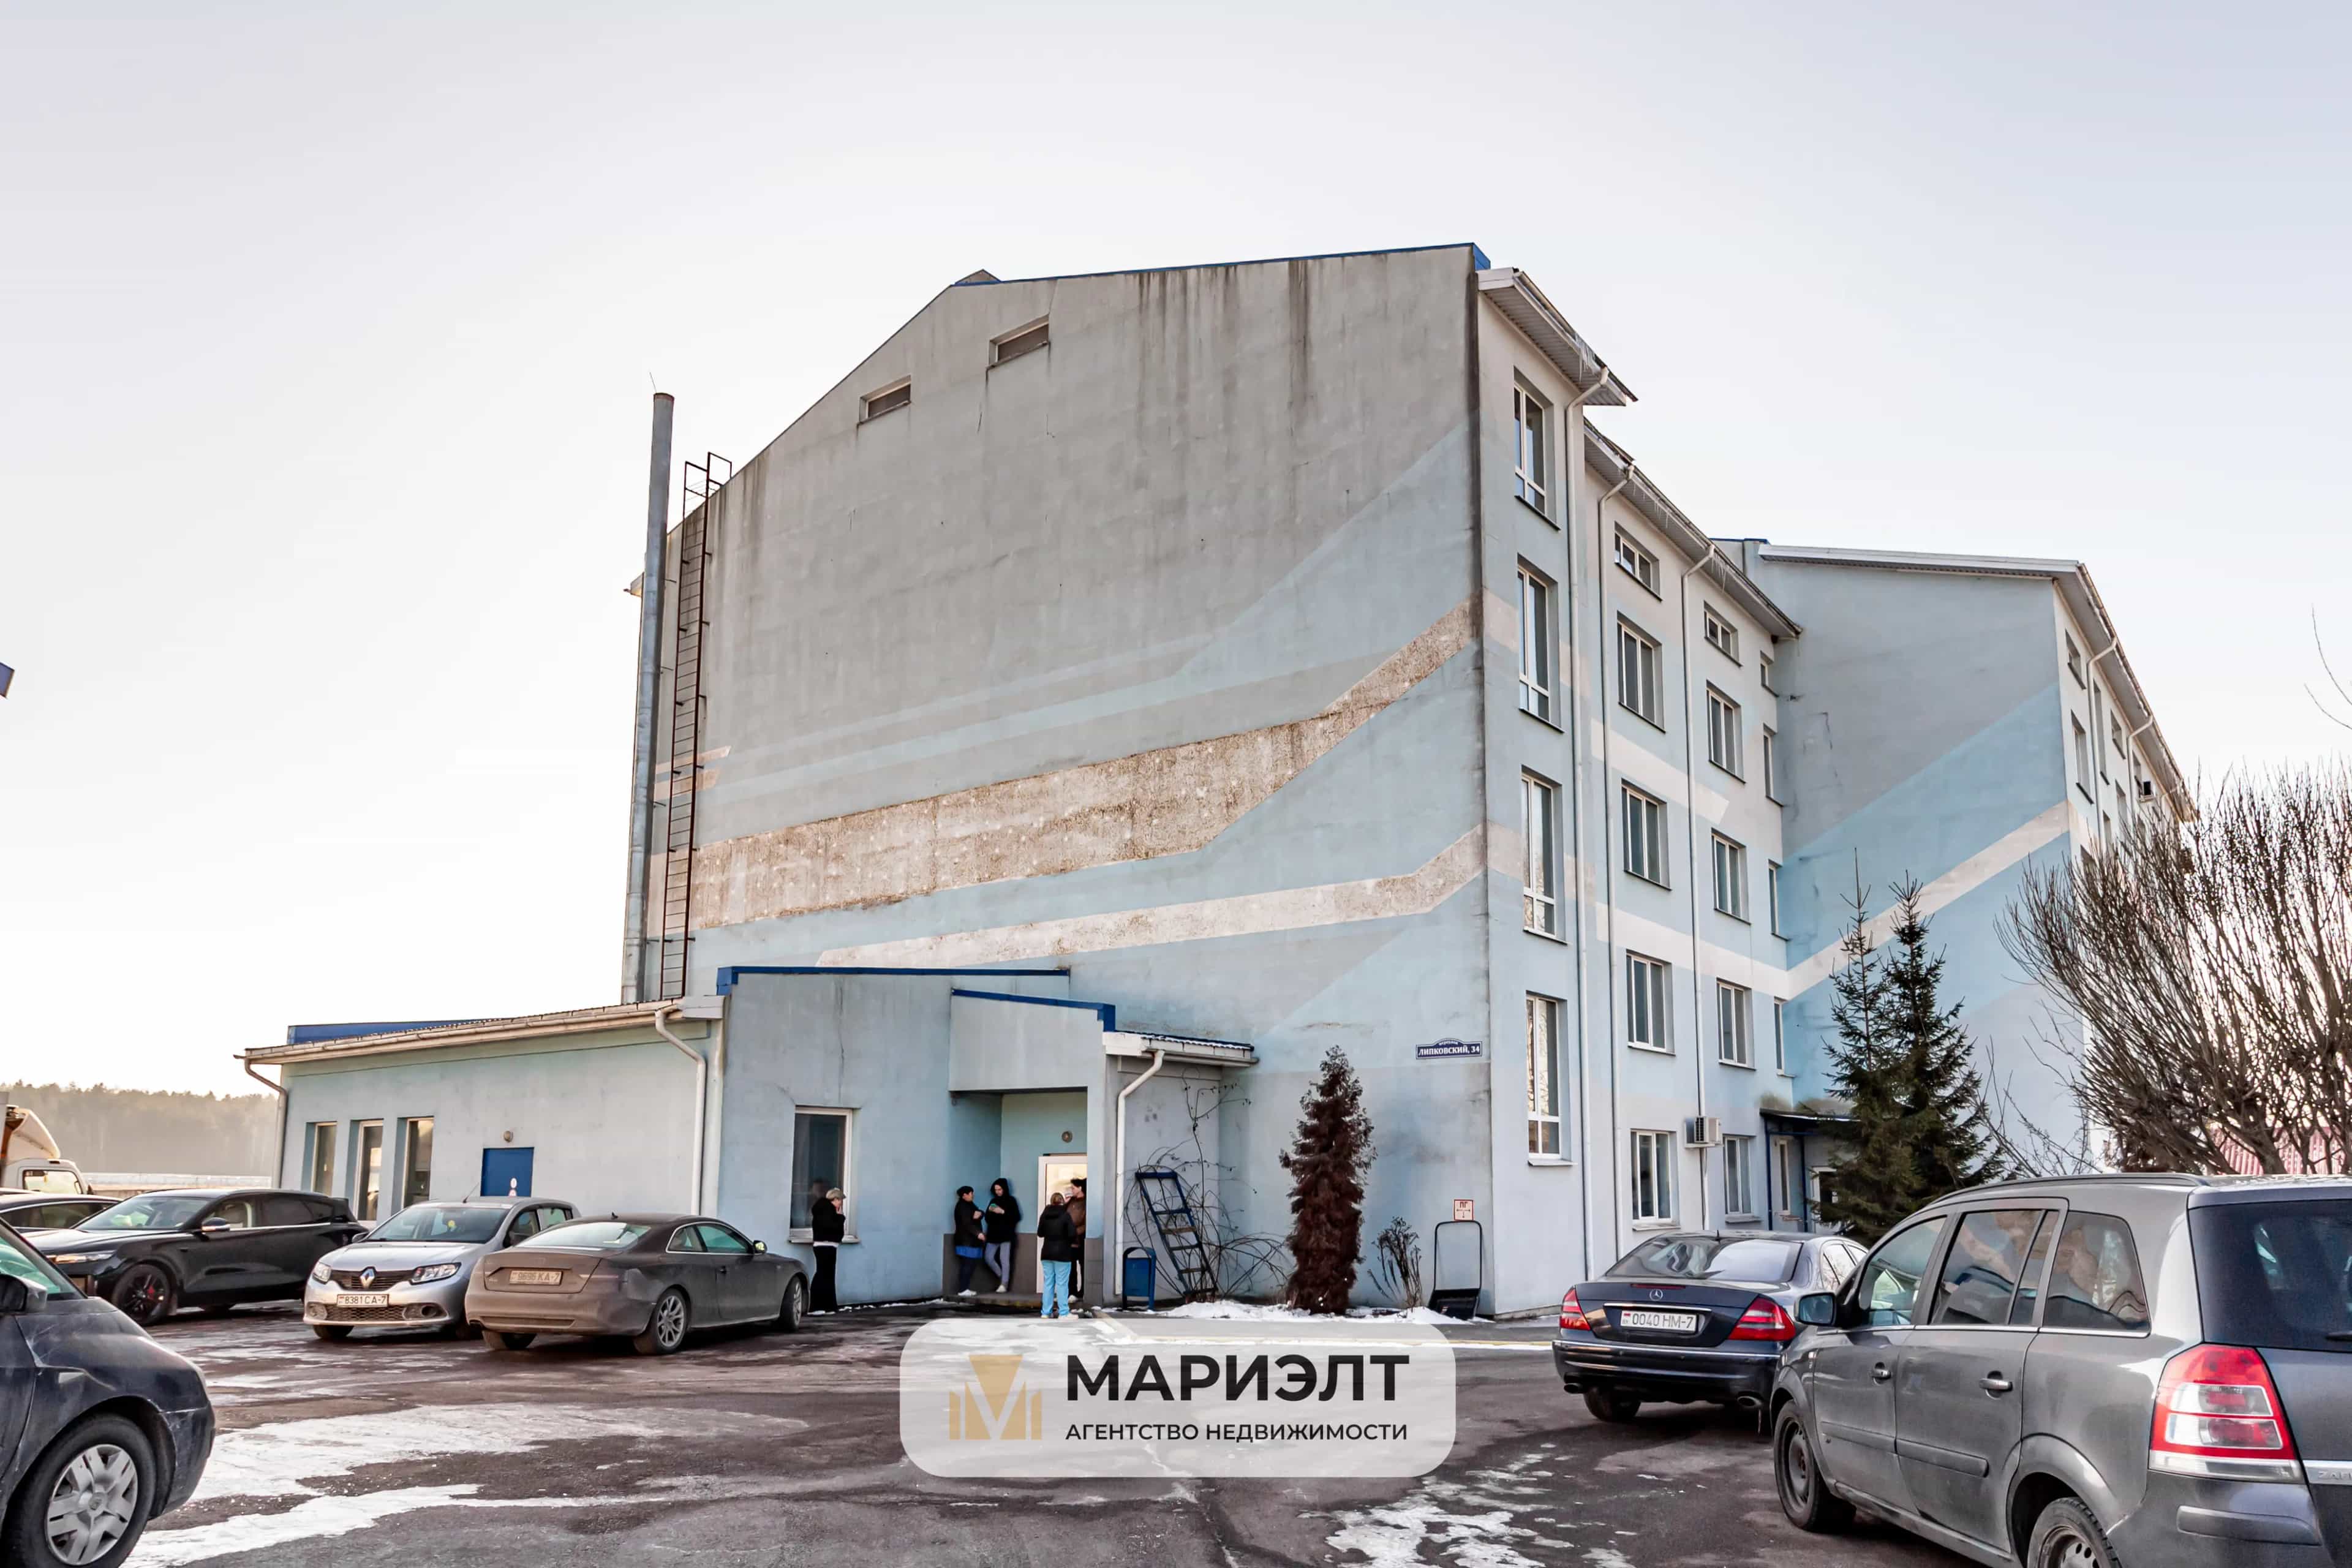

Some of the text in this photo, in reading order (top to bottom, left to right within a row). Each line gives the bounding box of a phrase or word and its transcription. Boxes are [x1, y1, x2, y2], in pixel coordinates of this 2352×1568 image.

[1419, 1045, 1470, 1055] ЛИПКОВСКИЙ,
[1632, 1313, 1694, 1329] 0040 HM-7
